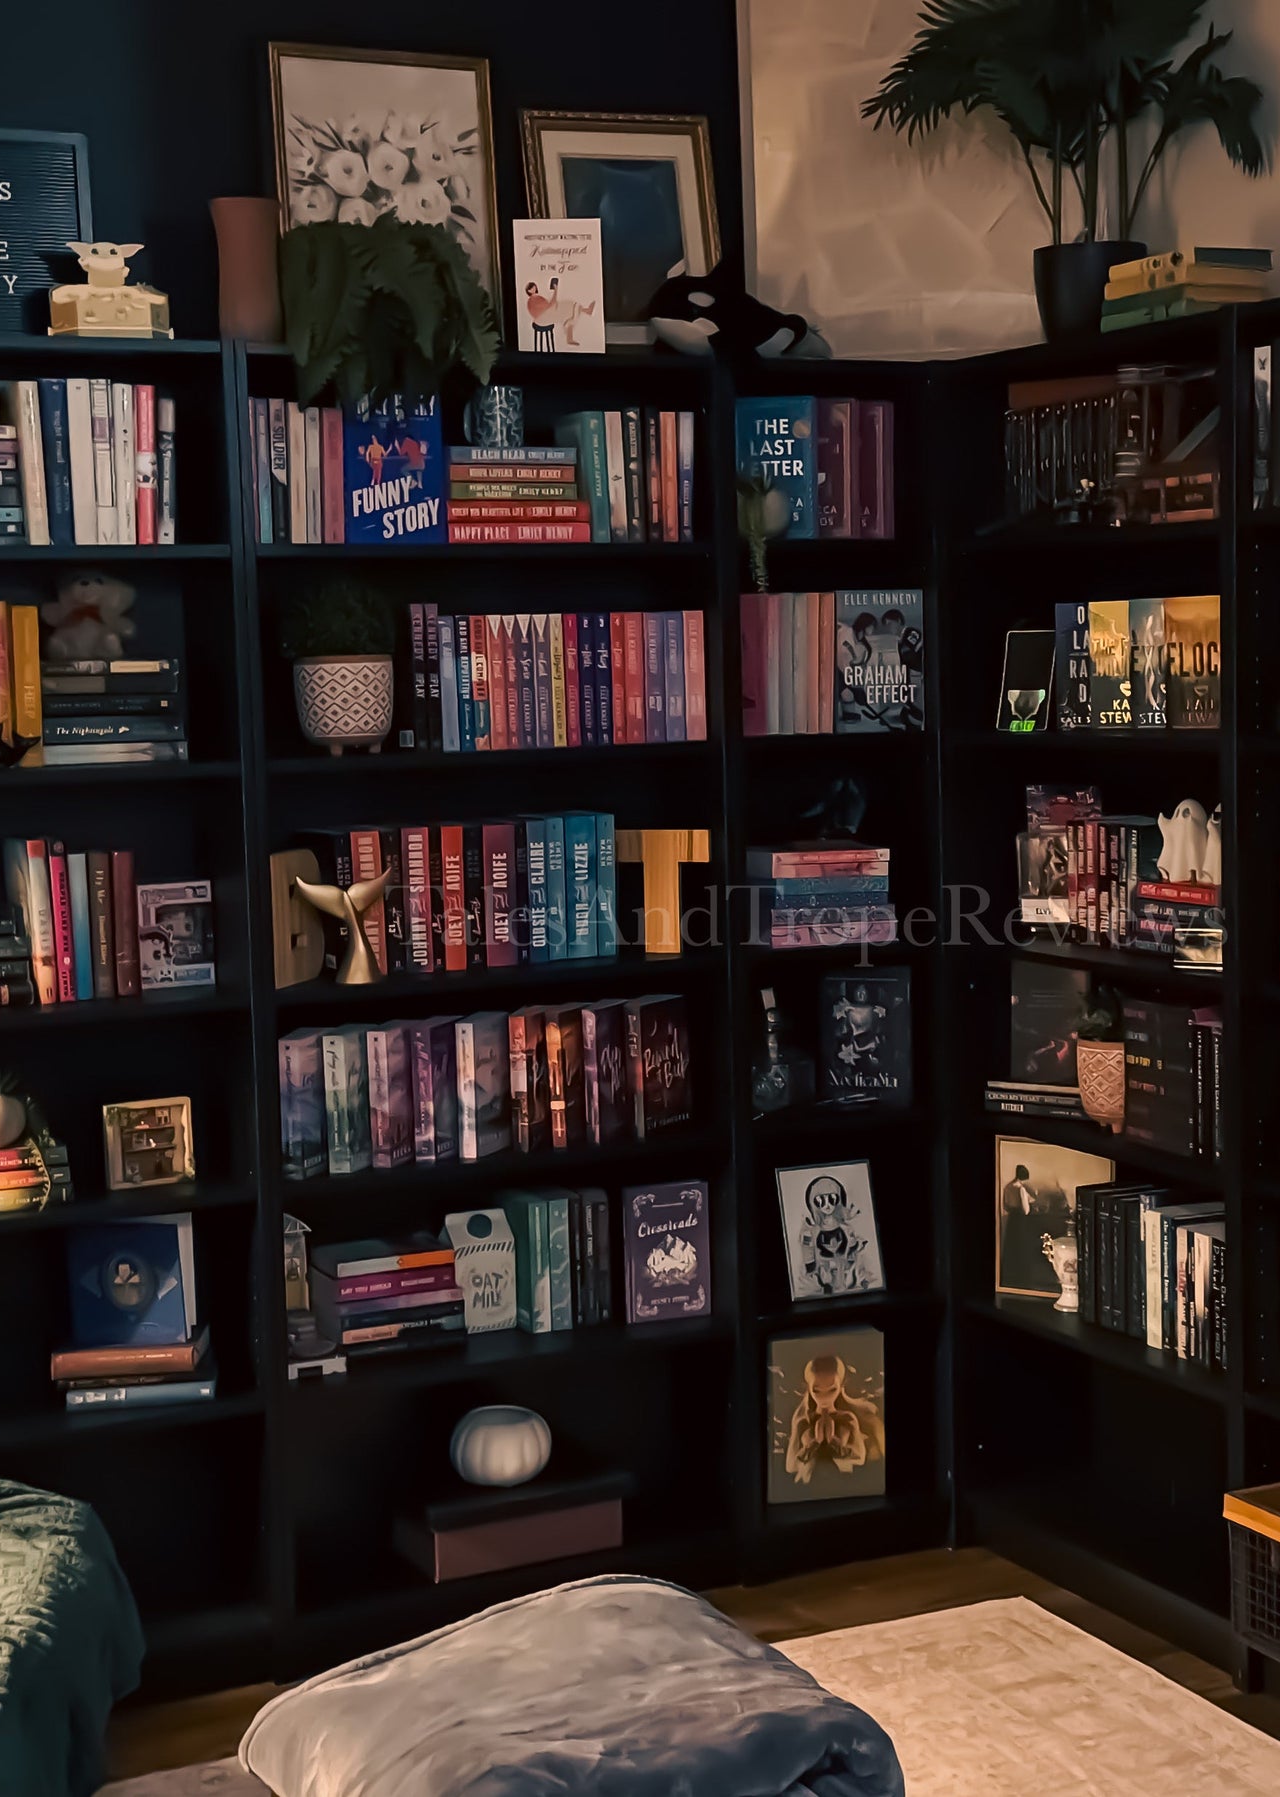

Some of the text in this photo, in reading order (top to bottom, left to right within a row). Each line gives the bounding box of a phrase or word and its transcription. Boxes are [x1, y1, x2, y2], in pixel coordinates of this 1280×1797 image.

[755, 418, 789, 435] THE
[272, 426, 286, 471] SOLDIER
[750, 439, 795, 457] LAST
[352, 476, 413, 518] FUNNY
[382, 498, 440, 539] STORY
[453, 527, 482, 541] HAPPY
[484, 527, 511, 541] PLACE
[517, 526, 544, 541] EMILY
[844, 592, 918, 606] ELLE KENNEDY
[844, 664, 908, 686] GRAHAM
[866, 684, 917, 704] EFFECT
[530, 841, 545, 885] CLAIRE
[574, 842, 589, 881] LIZZIE
[408, 834, 428, 966] JOHNNY SHANNON
[445, 855, 464, 946] JOEY AOIFE
[492, 852, 510, 943] JOEY AOIFE
[472, 1272, 503, 1289] OAT
[472, 1289, 503, 1309] MILK
